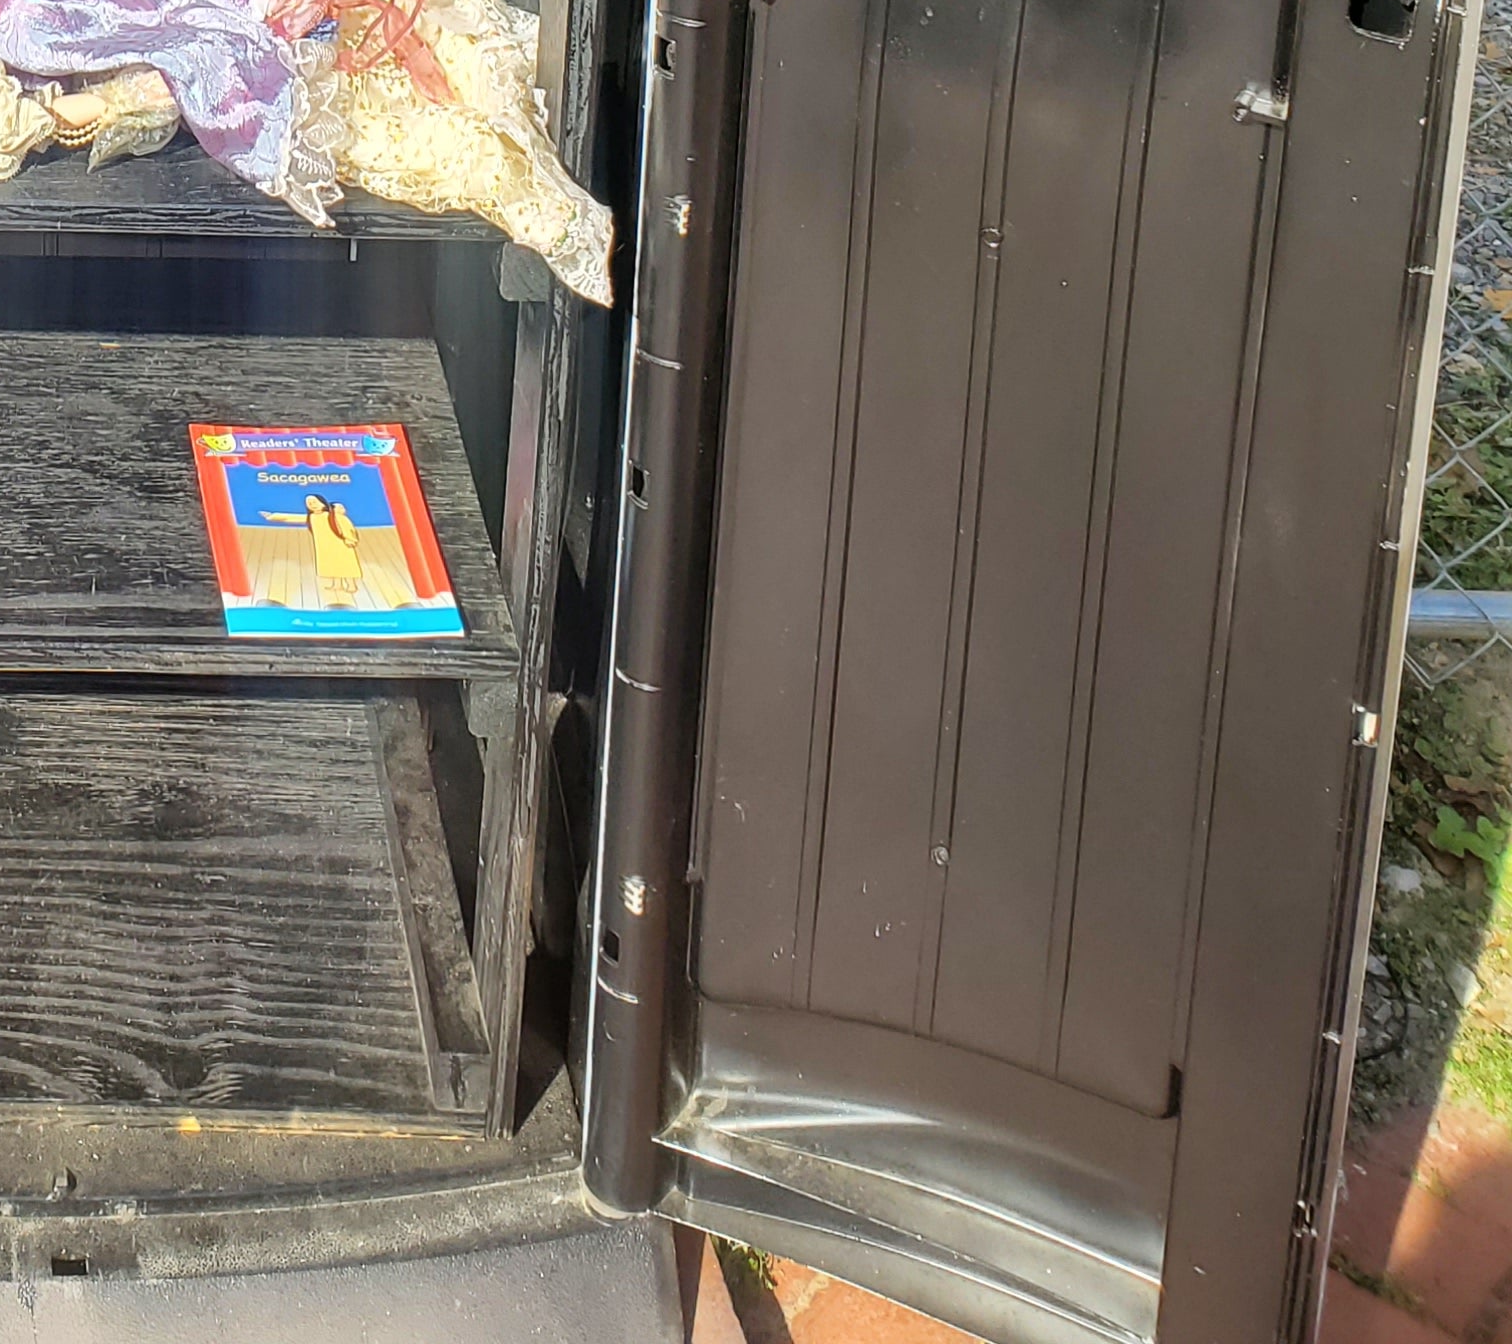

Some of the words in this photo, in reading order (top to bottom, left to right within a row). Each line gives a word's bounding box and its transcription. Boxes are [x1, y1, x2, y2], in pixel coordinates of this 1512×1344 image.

[241, 438, 299, 449] Readers'
[303, 437, 359, 449] Theater
[257, 471, 351, 486] Sacagawea
